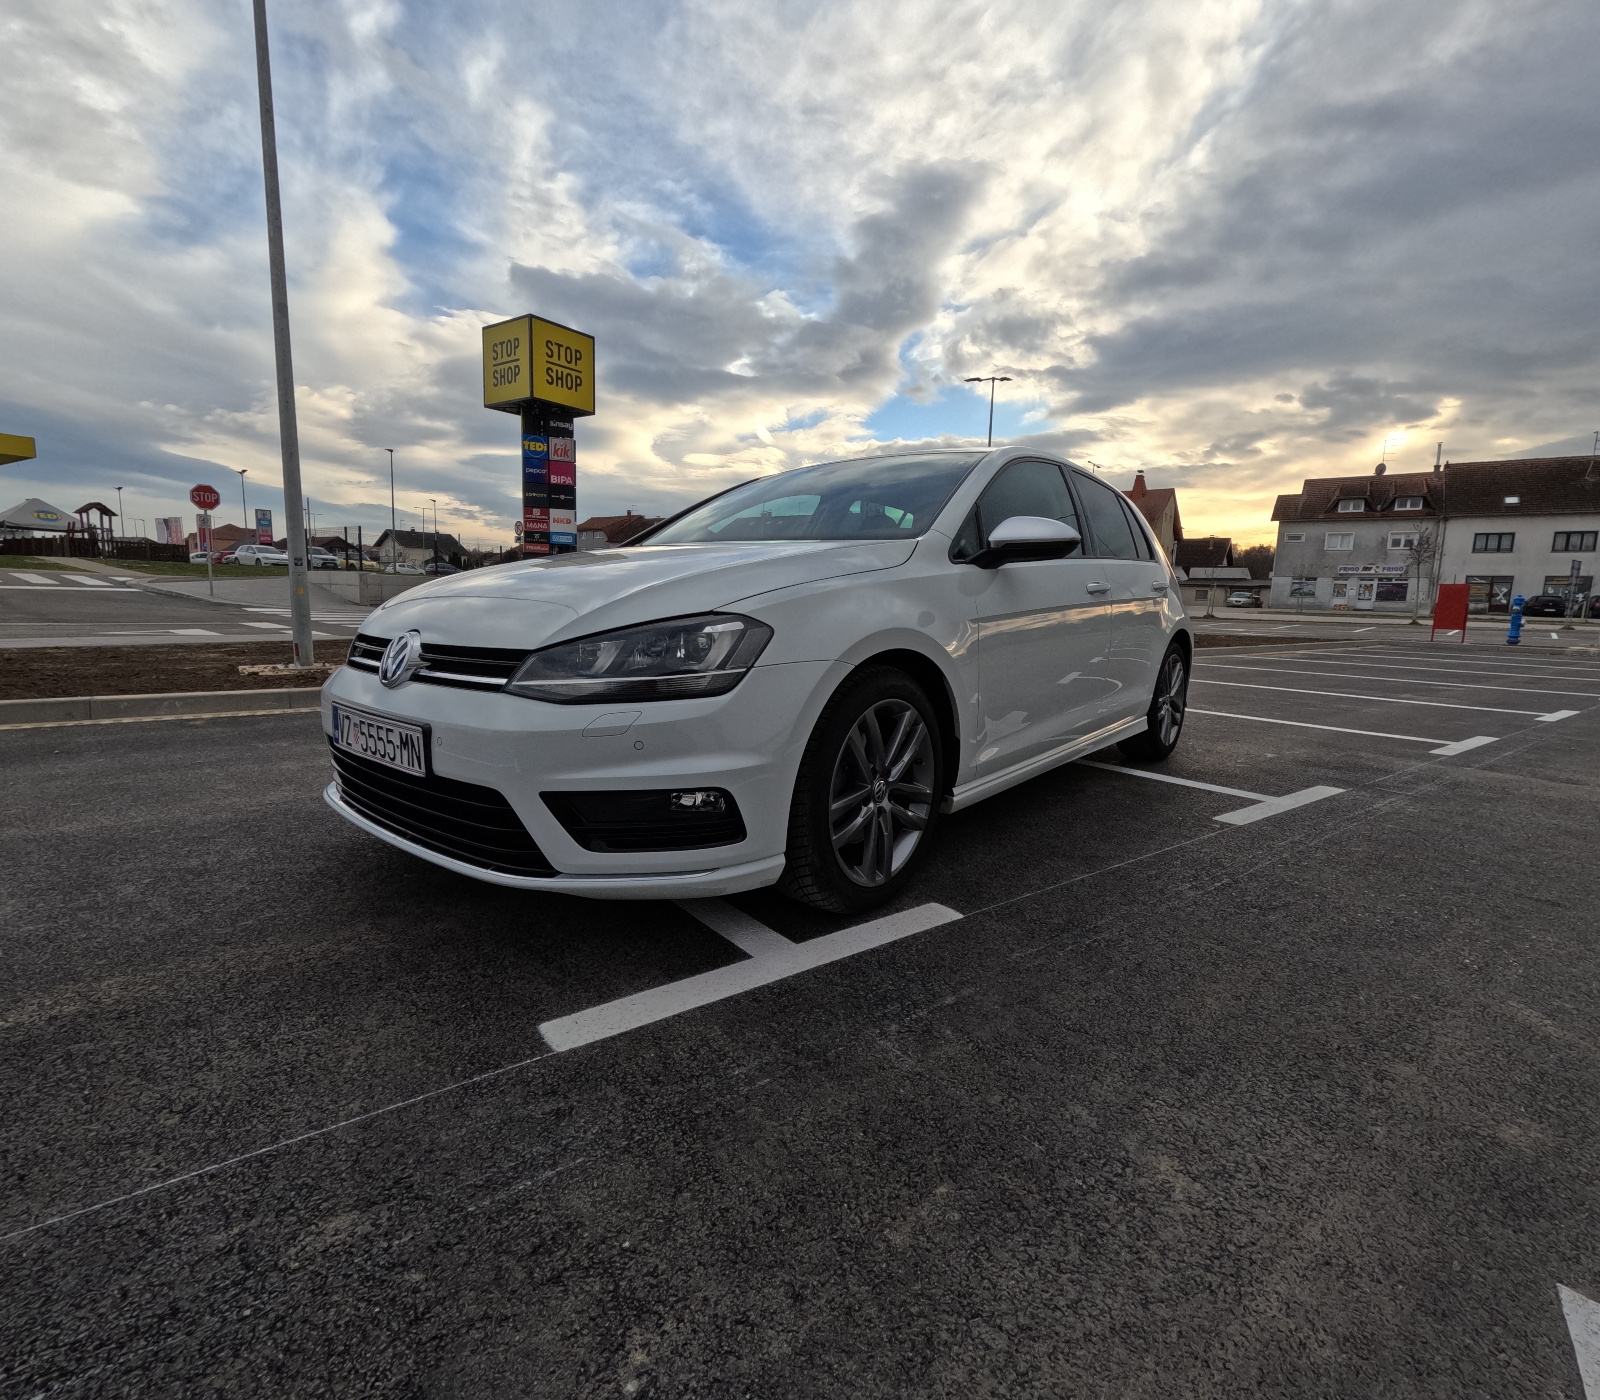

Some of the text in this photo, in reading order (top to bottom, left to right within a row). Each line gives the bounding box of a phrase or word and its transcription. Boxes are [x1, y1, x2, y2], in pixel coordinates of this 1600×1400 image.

[492, 337, 520, 361] STOP
[545, 339, 583, 366] STOP
[492, 364, 521, 387] SHOP
[545, 367, 583, 392] SHOP
[193, 491, 218, 503] STOP
